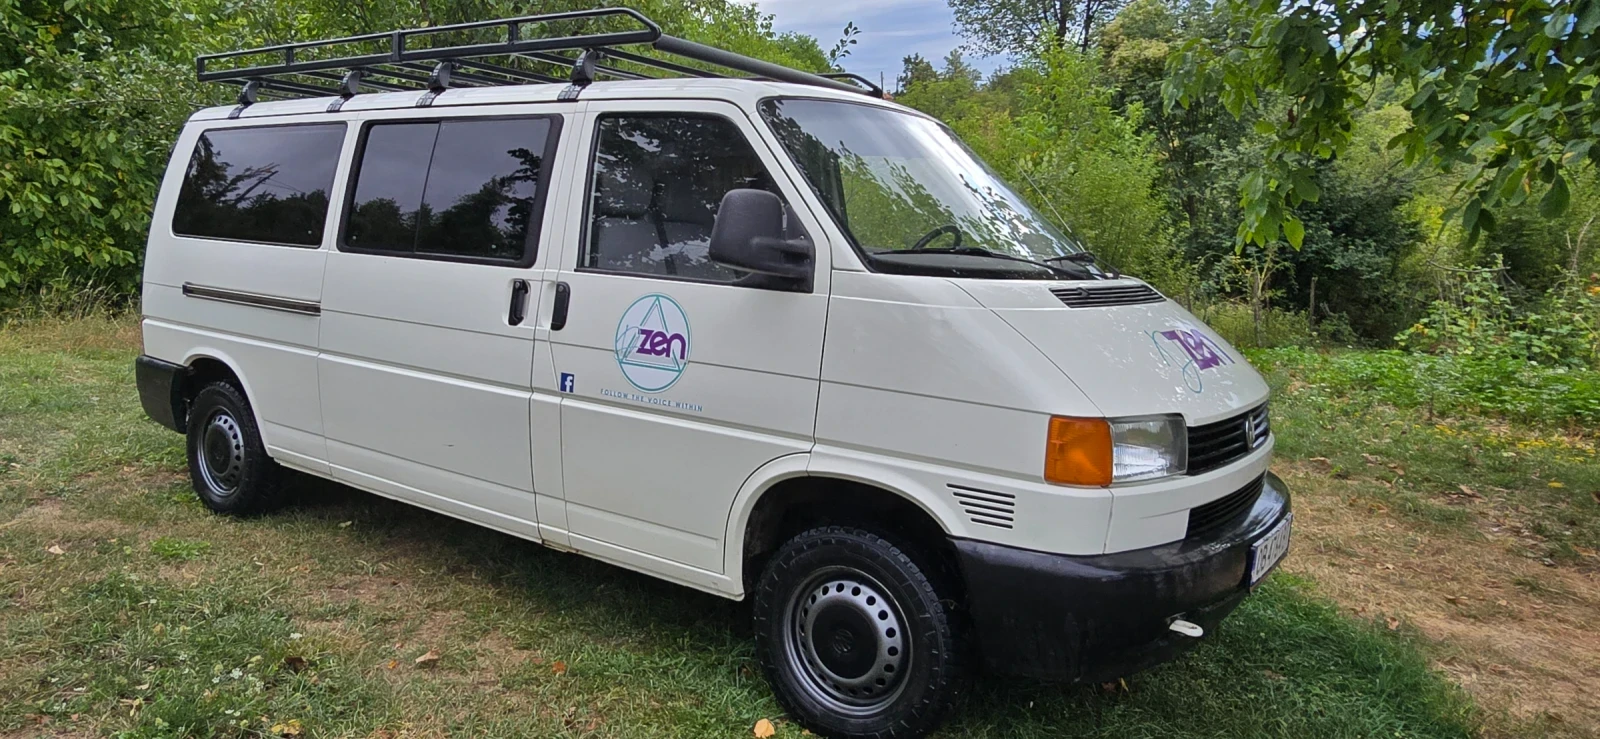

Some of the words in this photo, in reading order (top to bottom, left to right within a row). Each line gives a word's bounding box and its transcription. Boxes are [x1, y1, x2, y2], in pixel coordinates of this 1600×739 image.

[601, 388, 628, 399] FOLLOW
[631, 394, 644, 402] THE
[647, 398, 671, 407] VOICE
[675, 402, 703, 412] WITHIN
